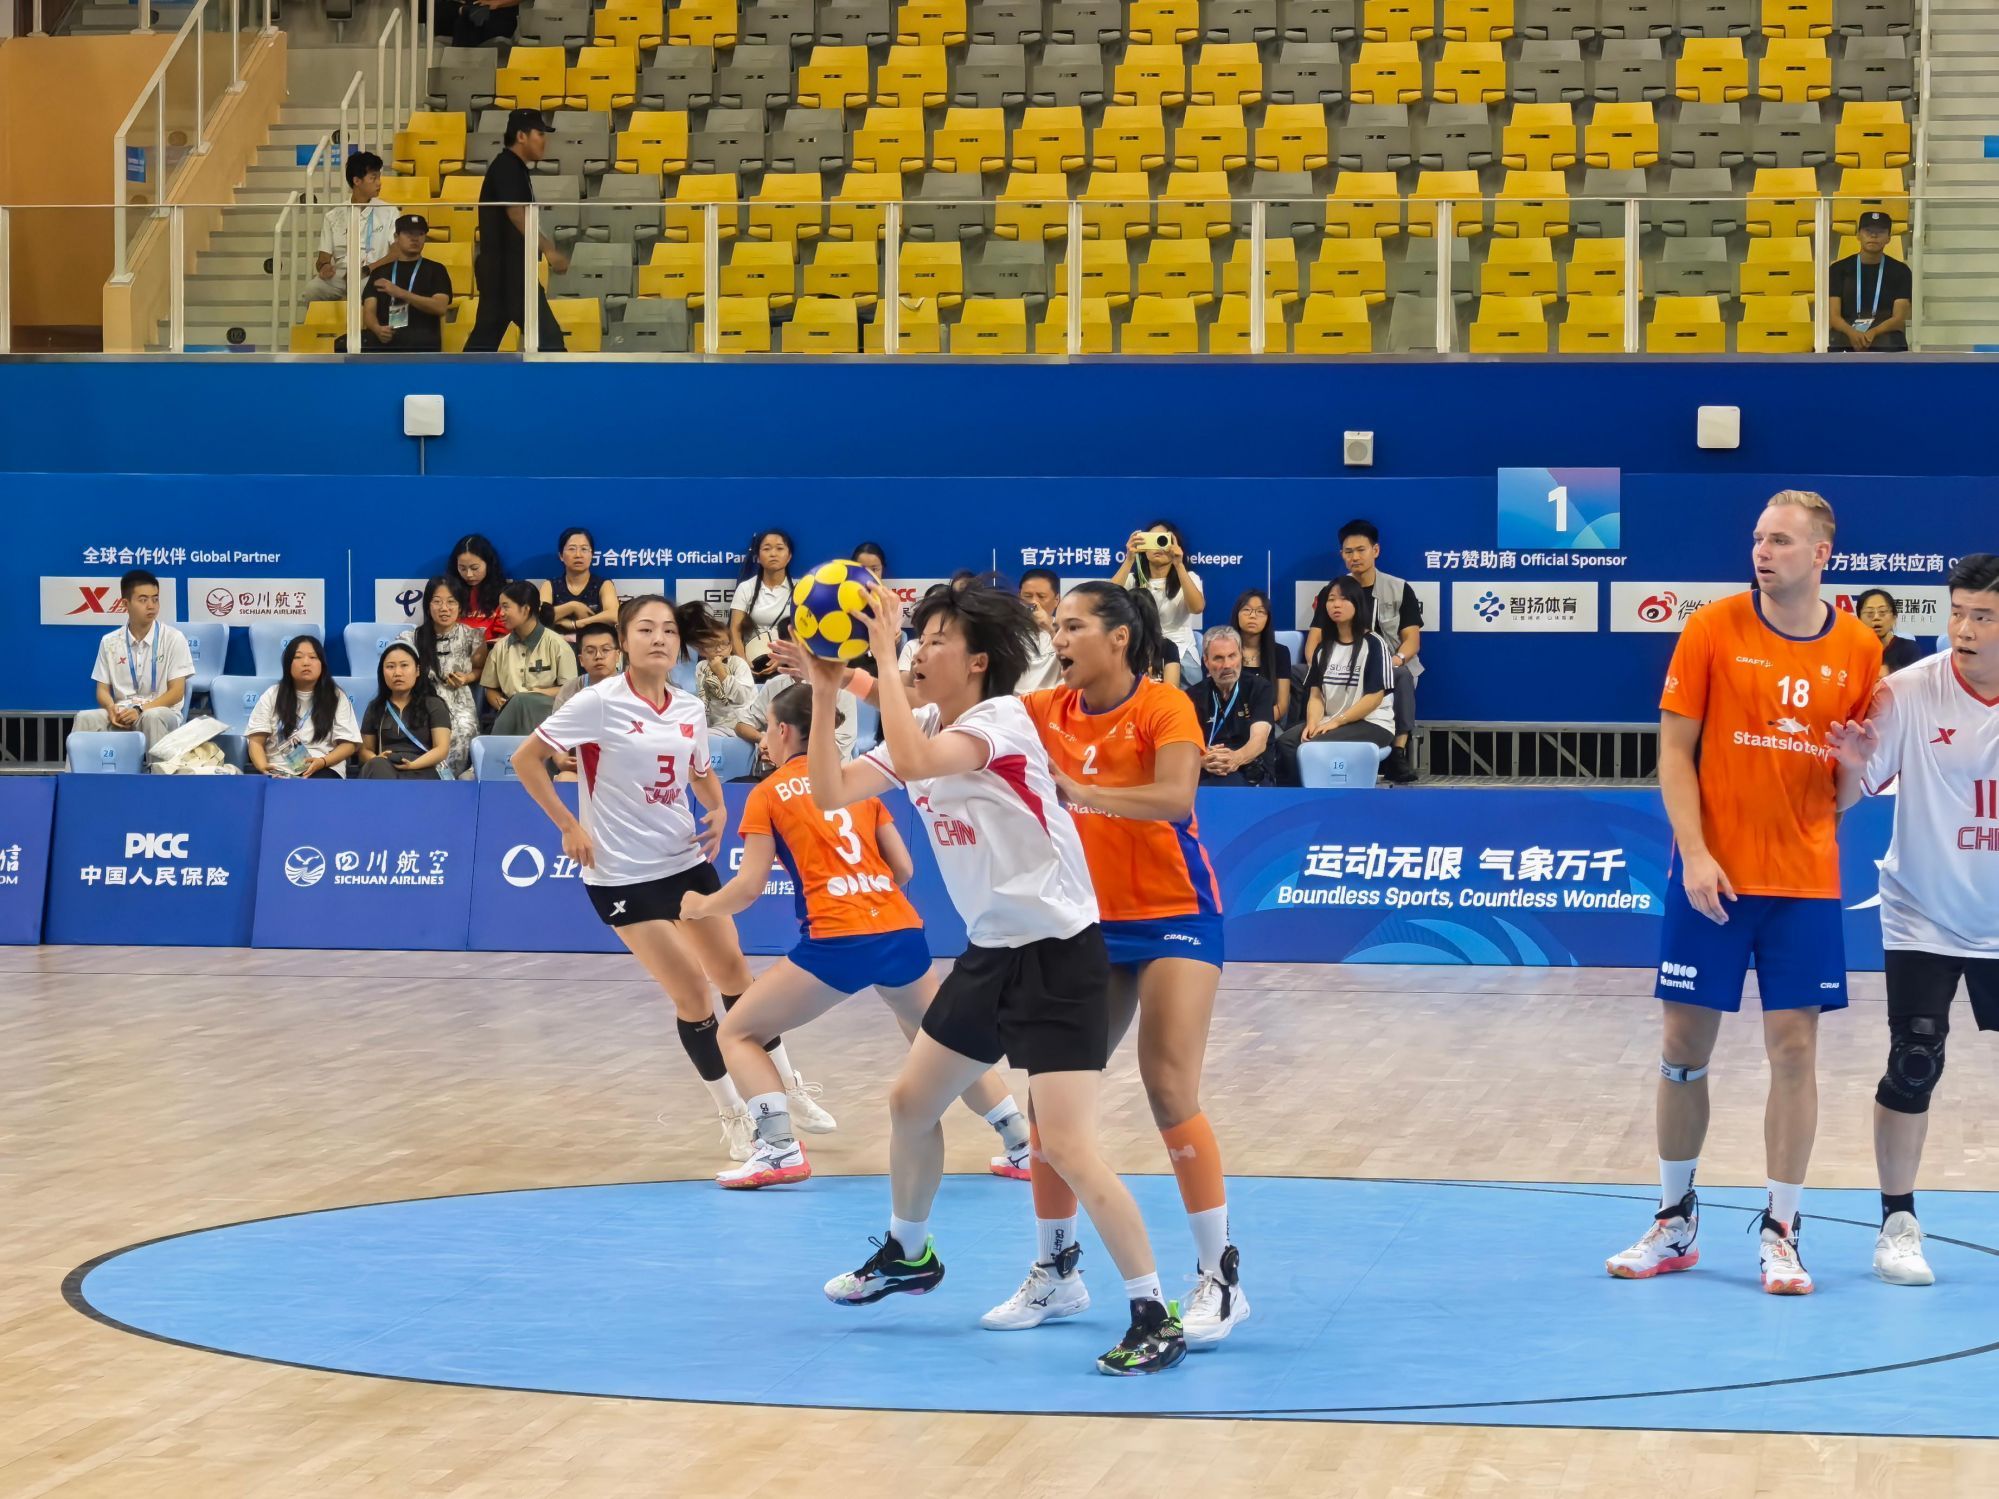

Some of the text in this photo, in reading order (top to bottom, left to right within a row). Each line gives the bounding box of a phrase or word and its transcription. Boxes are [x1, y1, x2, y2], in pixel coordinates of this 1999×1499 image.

[1546, 486, 1568, 532] 1
[83, 547, 281, 565] 全球合作伙伴 Global Partner
[676, 552, 723, 565] Official
[1021, 548, 1110, 566] 官方计时器
[1187, 553, 1244, 567] ekeeper
[1425, 550, 1627, 569] 官方赞助商 Official Sponsor
[239, 591, 307, 608] 四川航空
[1509, 596, 1577, 614] 智扬体育
[1777, 675, 1810, 708] 18
[655, 755, 676, 788] 3
[1082, 745, 1098, 775] 2
[824, 807, 862, 865] 3
[933, 820, 976, 846] CHN
[1957, 826, 1999, 852] CH
[125, 832, 189, 859] PICC
[335, 850, 449, 874] 四川航空
[1304, 843, 1627, 882] 运动无限 气象万千
[80, 865, 230, 887] 中国人民保险
[334, 875, 444, 885] SICHUAN AIRLINES
[1277, 885, 1651, 909] Boundless Sports, Countless Wonders
[1660, 975, 1696, 991] TeamNL
